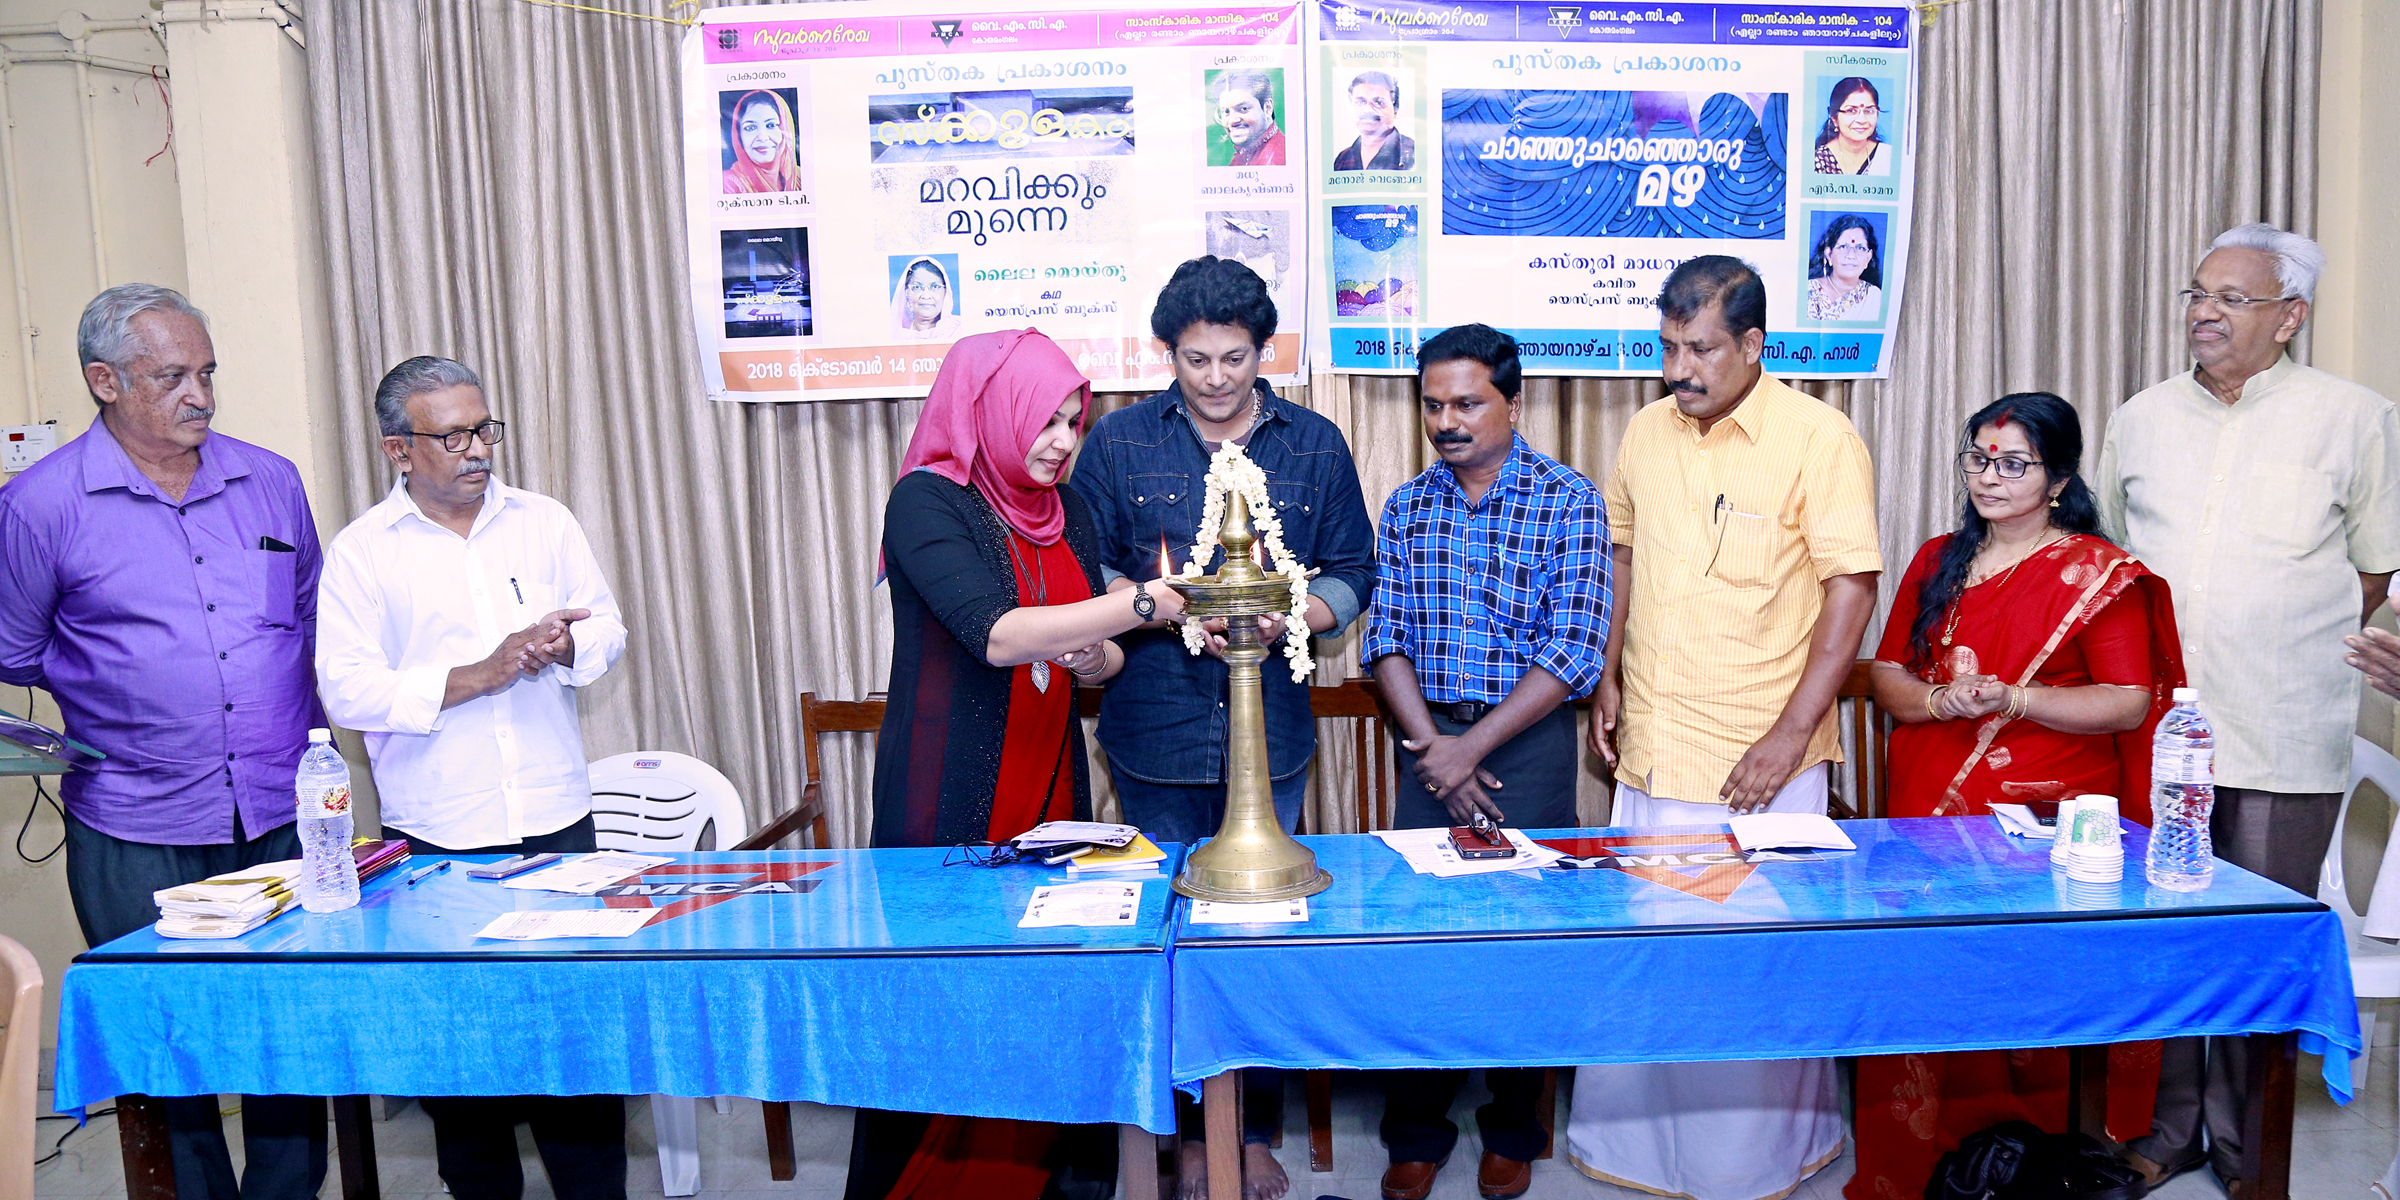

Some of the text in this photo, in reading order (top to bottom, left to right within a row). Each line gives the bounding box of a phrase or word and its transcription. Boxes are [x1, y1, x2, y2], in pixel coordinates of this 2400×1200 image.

[1819, 13, 1859, 26] മാസിക
[1873, 15, 1893, 26] 104
[1492, 48, 1742, 76] പുസ്തക പ്രകാശനം
[726, 70, 786, 83] പ്രകാശനം
[875, 60, 1127, 90] പുസ്തക പ്രകാശനം
[920, 166, 1106, 210] മറവിക്കും
[1635, 164, 1706, 208] മഴ
[1592, 277, 1636, 289] കവിത
[1040, 290, 1062, 300] കഥ
[1355, 340, 1386, 356] 2018
[1823, 342, 1860, 360] ഹാൾ
[747, 362, 783, 380] 2018
[888, 357, 907, 374] 14
[1560, 850, 1795, 868] YMCA
